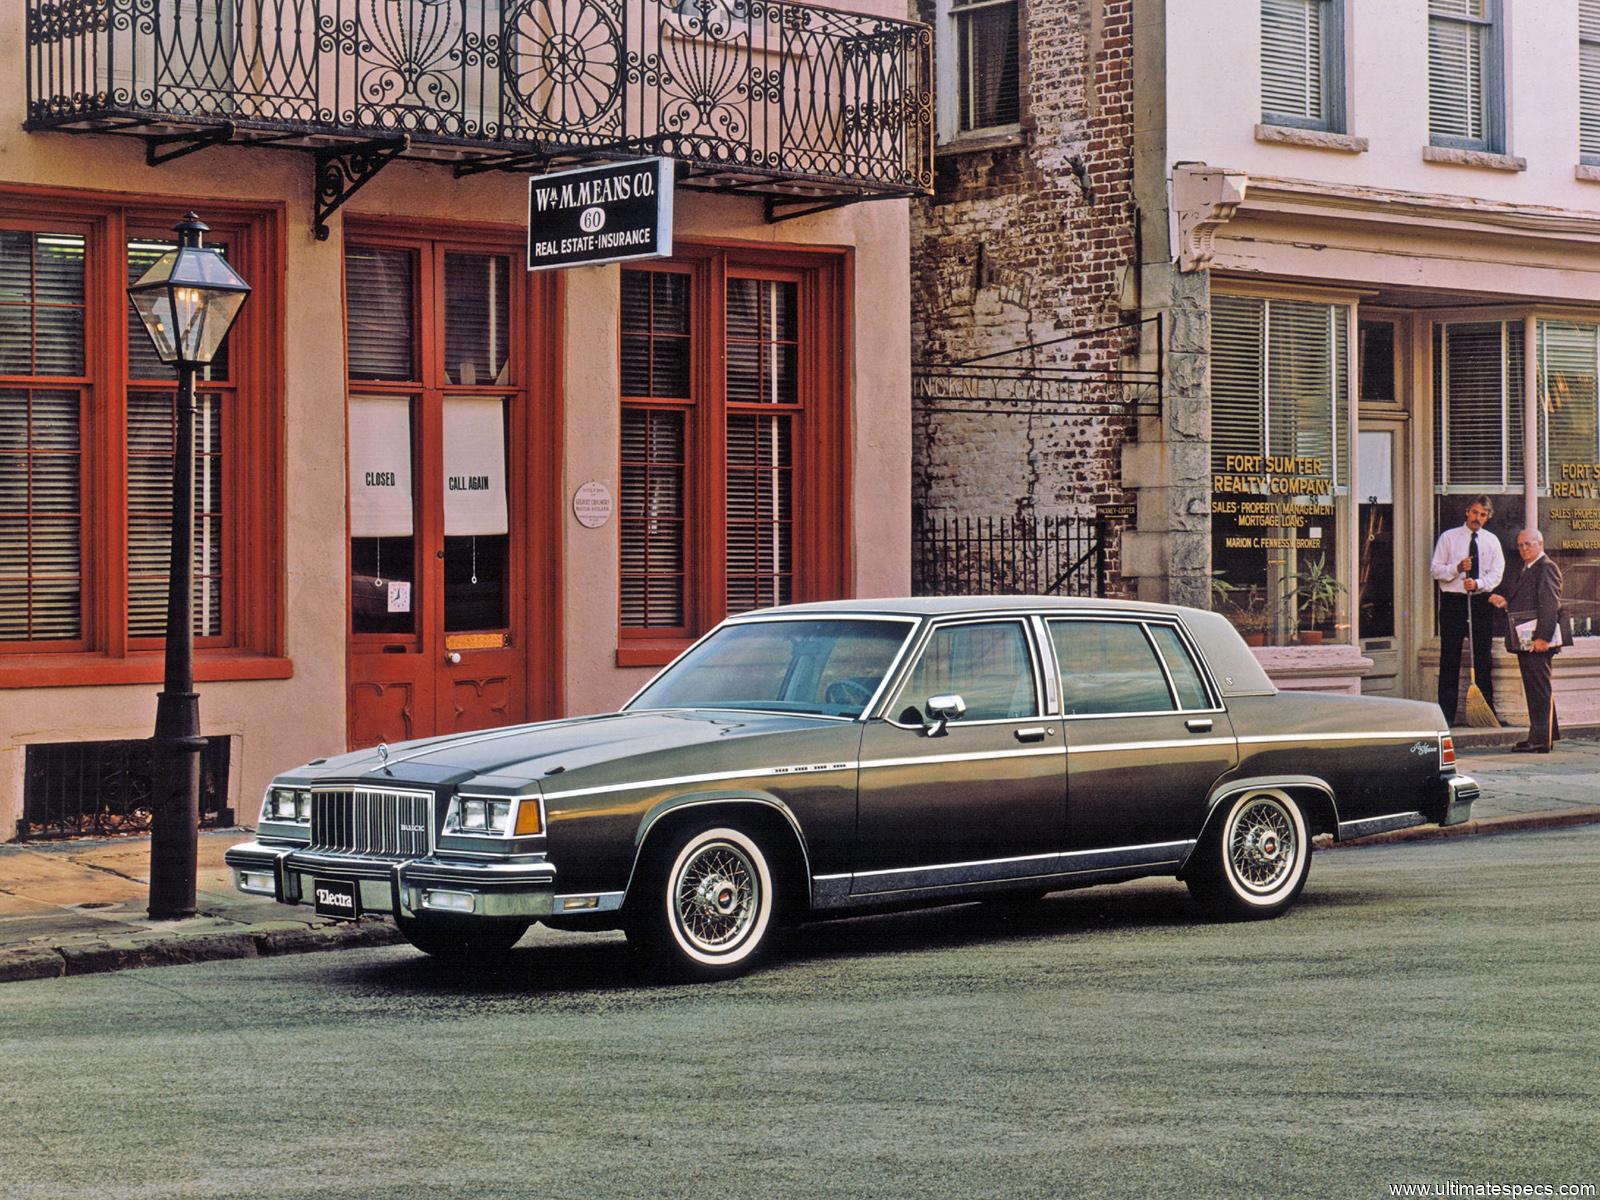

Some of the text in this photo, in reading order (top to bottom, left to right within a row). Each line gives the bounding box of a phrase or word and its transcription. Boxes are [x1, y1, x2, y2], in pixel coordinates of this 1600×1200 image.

[633, 172, 655, 198] CO.
[584, 211, 601, 229] 60
[535, 241, 559, 256] REAL
[1226, 455, 1322, 474] FORT SUMTER
[1562, 464, 1591, 479] FORT
[365, 472, 396, 486] CLOSED
[448, 476, 489, 490] CALL AGAIN
[1214, 476, 1332, 496] REALTY COMPANY
[1553, 481, 1594, 498] REALTY
[1212, 501, 1335, 516] SALES PROPERTY MANAGEMENT
[1238, 515, 1305, 527] MORTGAGE LOANS
[1226, 538, 1252, 548] MARION
[1295, 539, 1320, 549] BROKER
[316, 889, 353, 907] Electra
